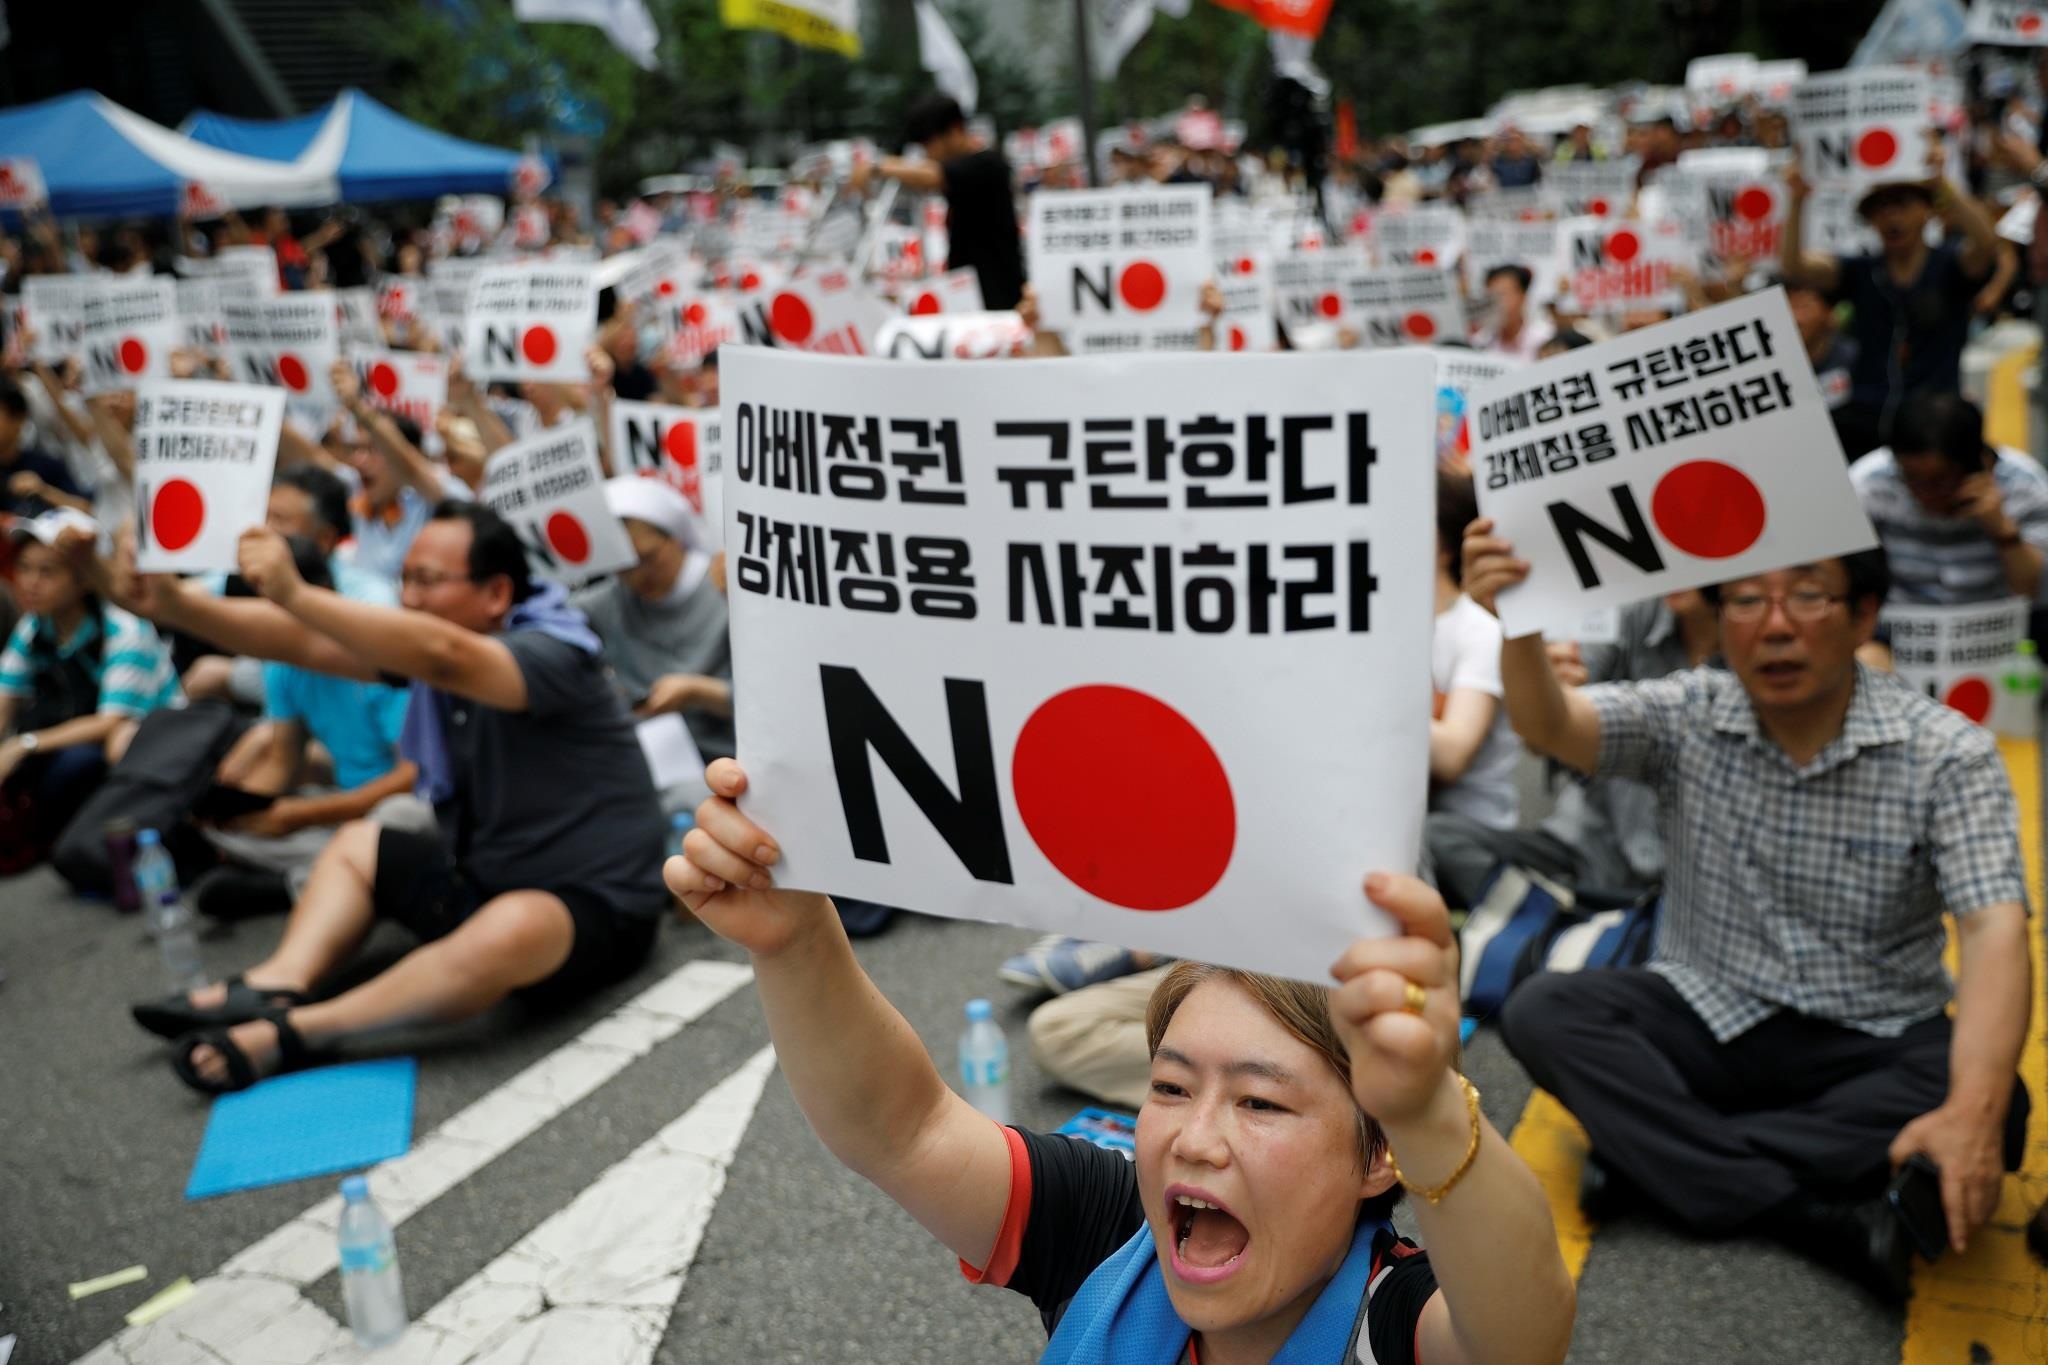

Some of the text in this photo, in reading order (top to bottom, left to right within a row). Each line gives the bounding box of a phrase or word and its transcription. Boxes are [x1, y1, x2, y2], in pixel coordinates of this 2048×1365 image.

[1815, 126, 1900, 173] NO
[1573, 228, 1641, 269] NO
[1072, 258, 1168, 315] NO
[483, 322, 560, 369] NO
[1366, 310, 1438, 340] NO
[90, 335, 149, 377] NO
[1477, 317, 1776, 442] 아베정권 규탄한다
[625, 417, 699, 469] NO
[737, 402, 968, 506] 아베정권
[995, 411, 1379, 510] 규탄한다
[1483, 370, 1795, 492] 강제징용 사죄하라
[1547, 459, 1767, 590] NO
[737, 510, 1379, 635] 강제징용 사죄하라
[819, 663, 1238, 912] NO
